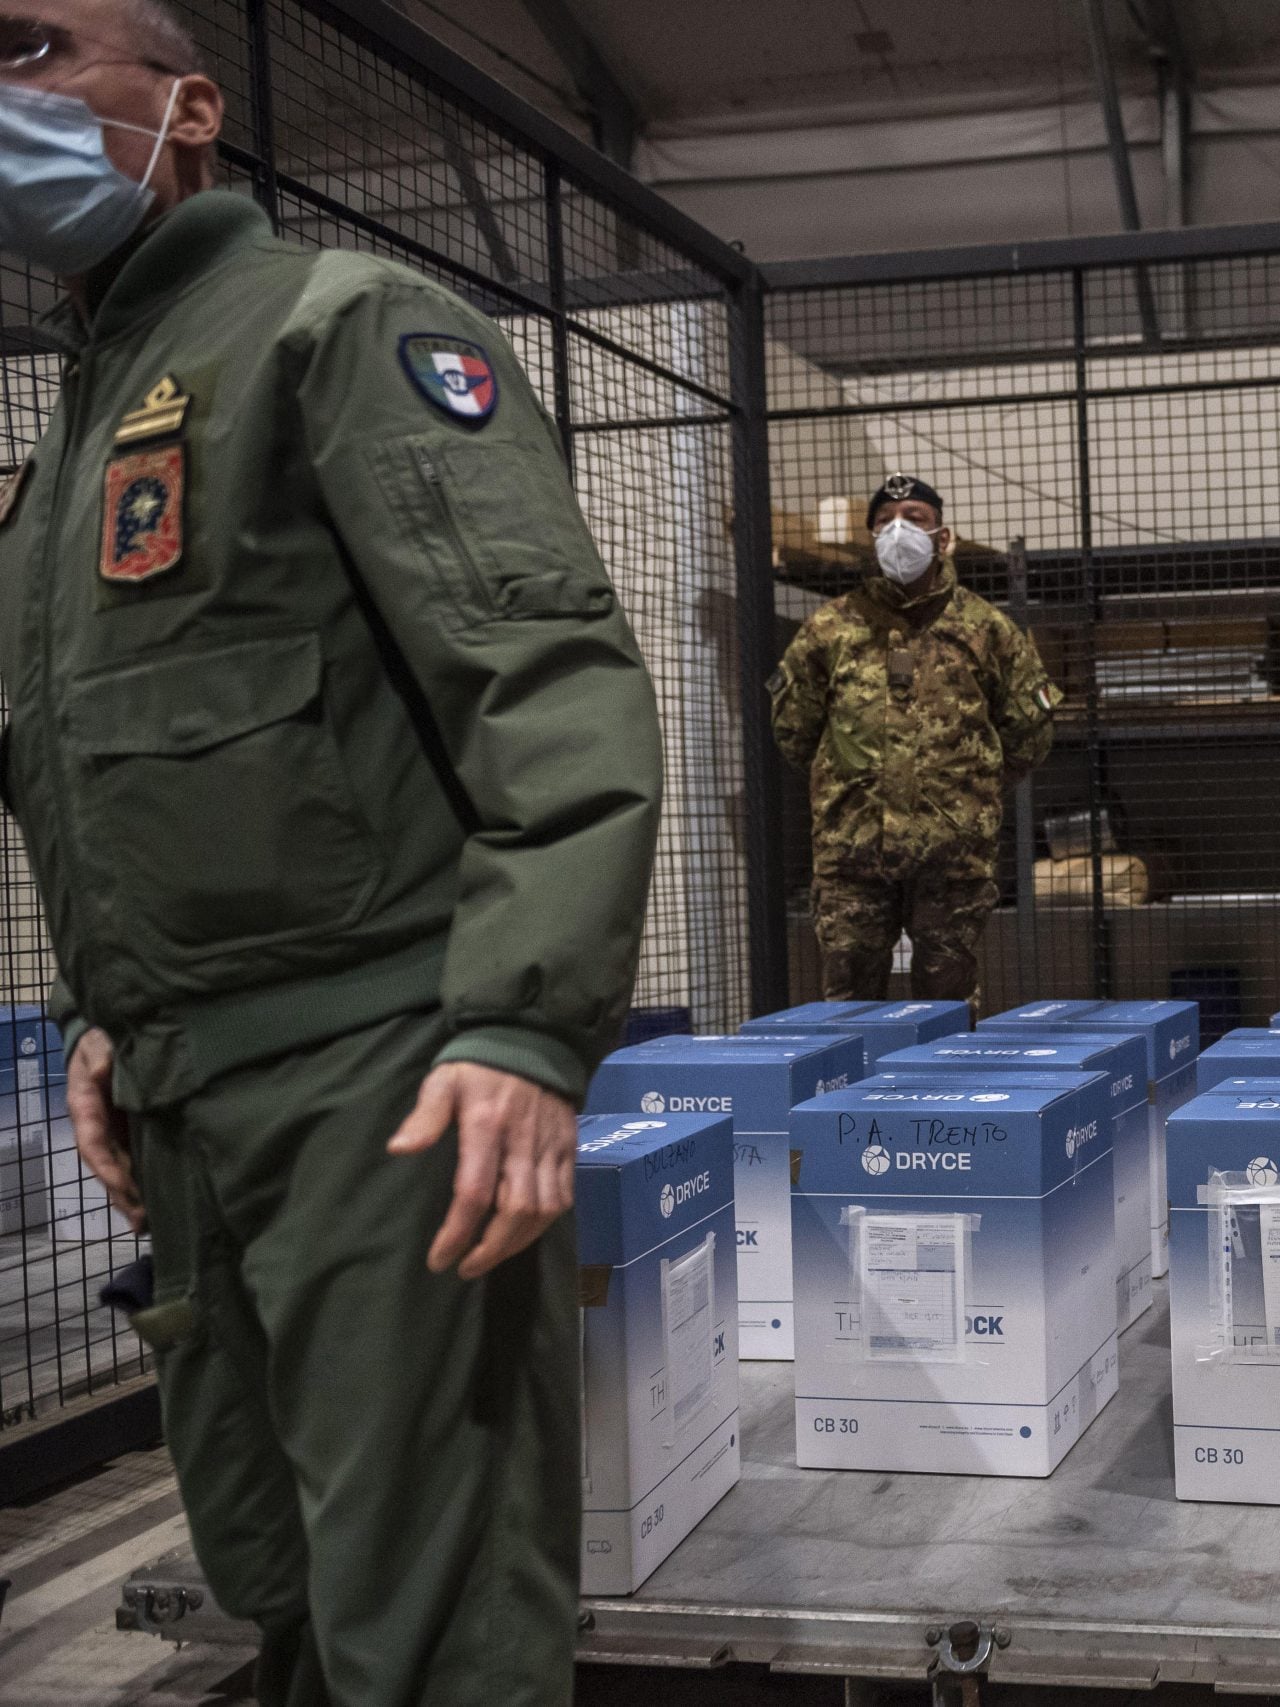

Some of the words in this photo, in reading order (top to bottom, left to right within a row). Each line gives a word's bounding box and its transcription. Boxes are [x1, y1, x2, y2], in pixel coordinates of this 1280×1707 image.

[669, 1097, 733, 1112] DRYCE
[838, 1113, 893, 1146] P.A.
[909, 1119, 1008, 1147] TRENTO
[1075, 1120, 1097, 1149] DRYCE
[733, 1143, 767, 1166] STA
[895, 1152, 971, 1170] DRYCE
[676, 1170, 710, 1205] DRYCE
[736, 1230, 758, 1246] CK
[814, 1417, 835, 1433] CB
[839, 1418, 858, 1434] 30
[1195, 1448, 1218, 1463] CB
[1223, 1449, 1244, 1464] 30
[641, 1515, 653, 1539] CB
[654, 1503, 664, 1527] 30
